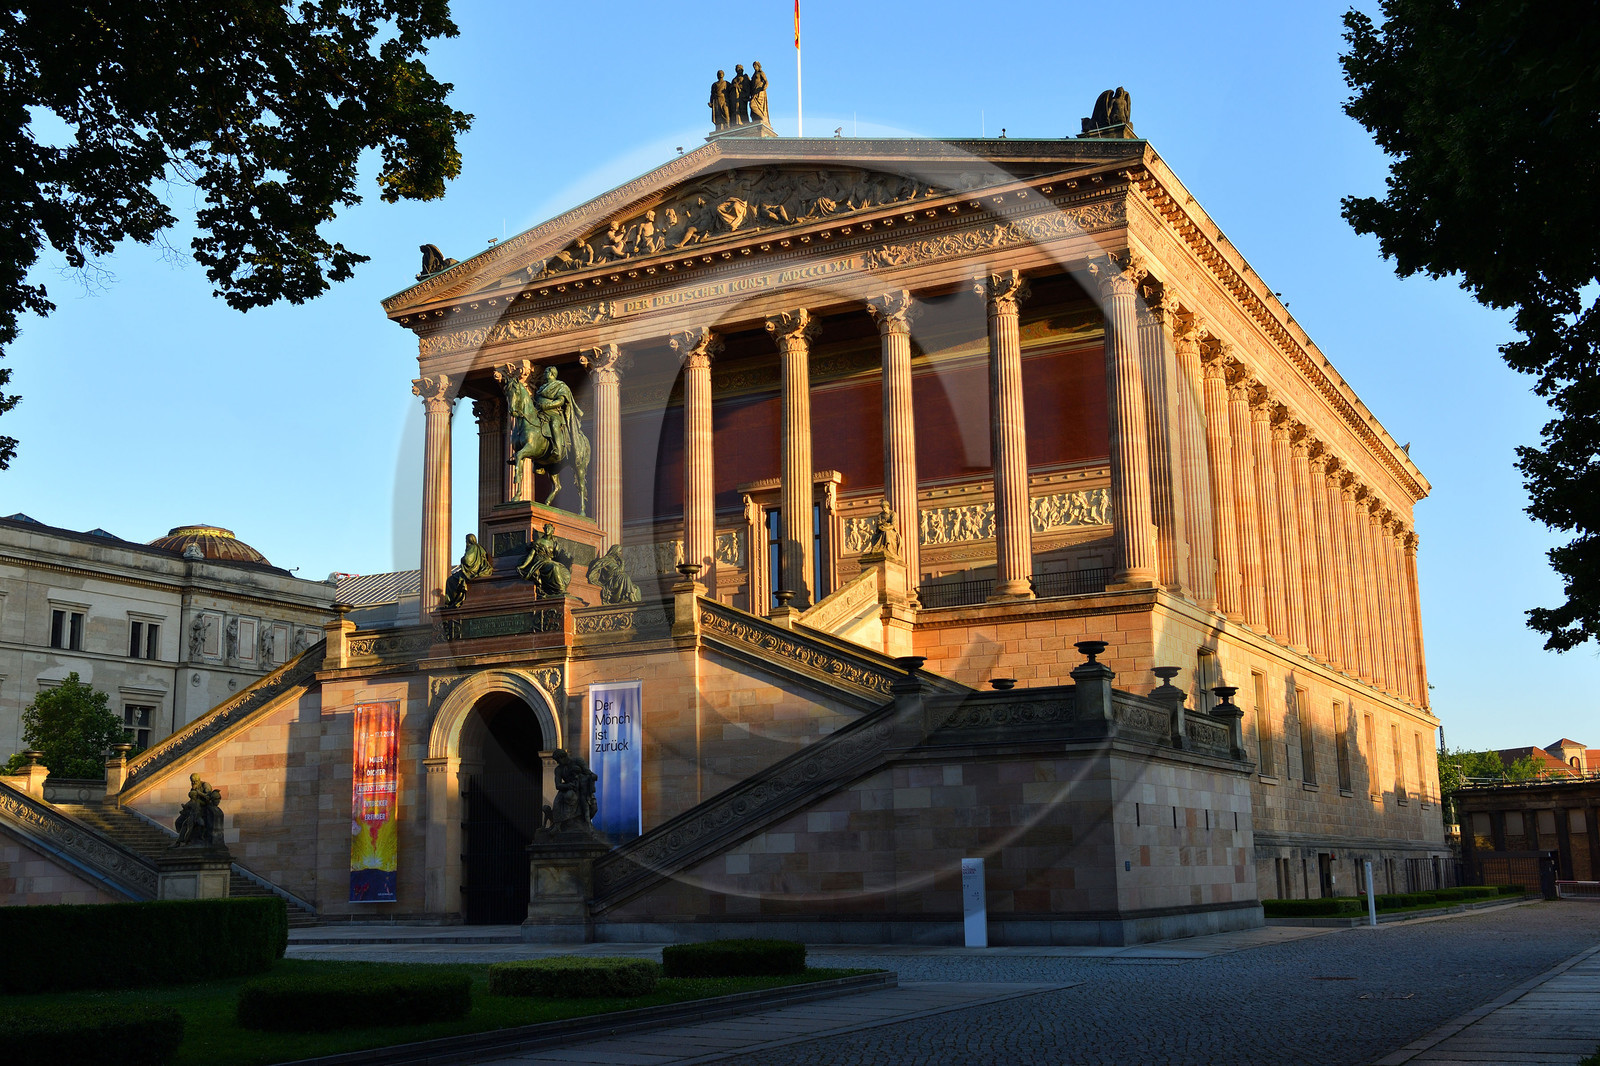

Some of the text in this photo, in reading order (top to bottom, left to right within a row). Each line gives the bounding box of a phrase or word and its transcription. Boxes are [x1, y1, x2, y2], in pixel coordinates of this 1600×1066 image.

[627, 259, 854, 312] DER DEUTSCHEN KUNST MDCCCLXXI
[595, 700, 613, 711] Der
[595, 712, 630, 725] Mönch
[595, 729, 607, 740] ist
[595, 739, 629, 752] zurück
